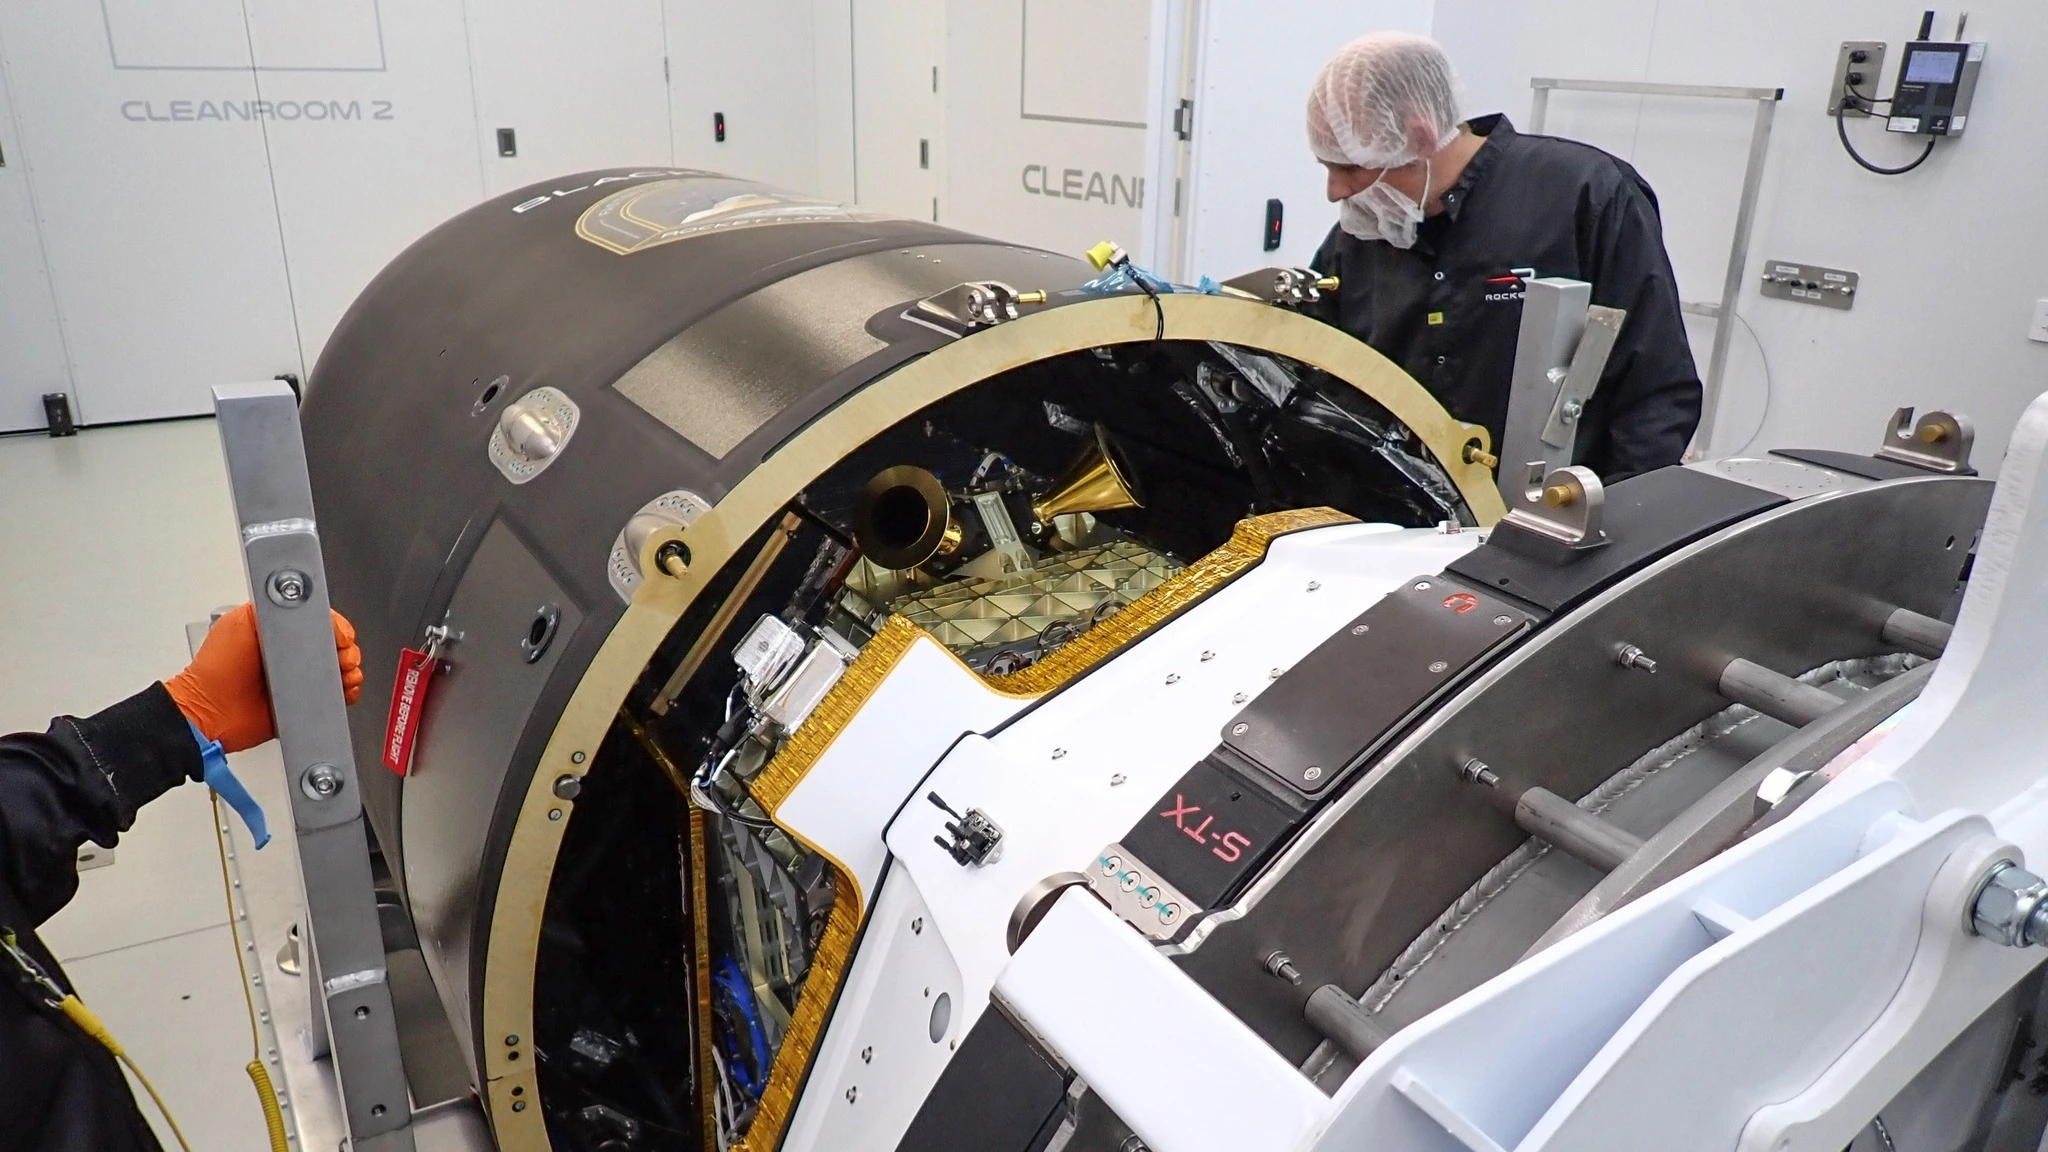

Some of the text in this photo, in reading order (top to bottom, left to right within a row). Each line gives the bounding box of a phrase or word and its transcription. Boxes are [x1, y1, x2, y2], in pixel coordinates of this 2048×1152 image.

[121, 100, 395, 122] CLEANROOM 2
[389, 668, 420, 765] REMOVE BEFORE FLIGHT
[1160, 793, 1251, 862] S-TX
